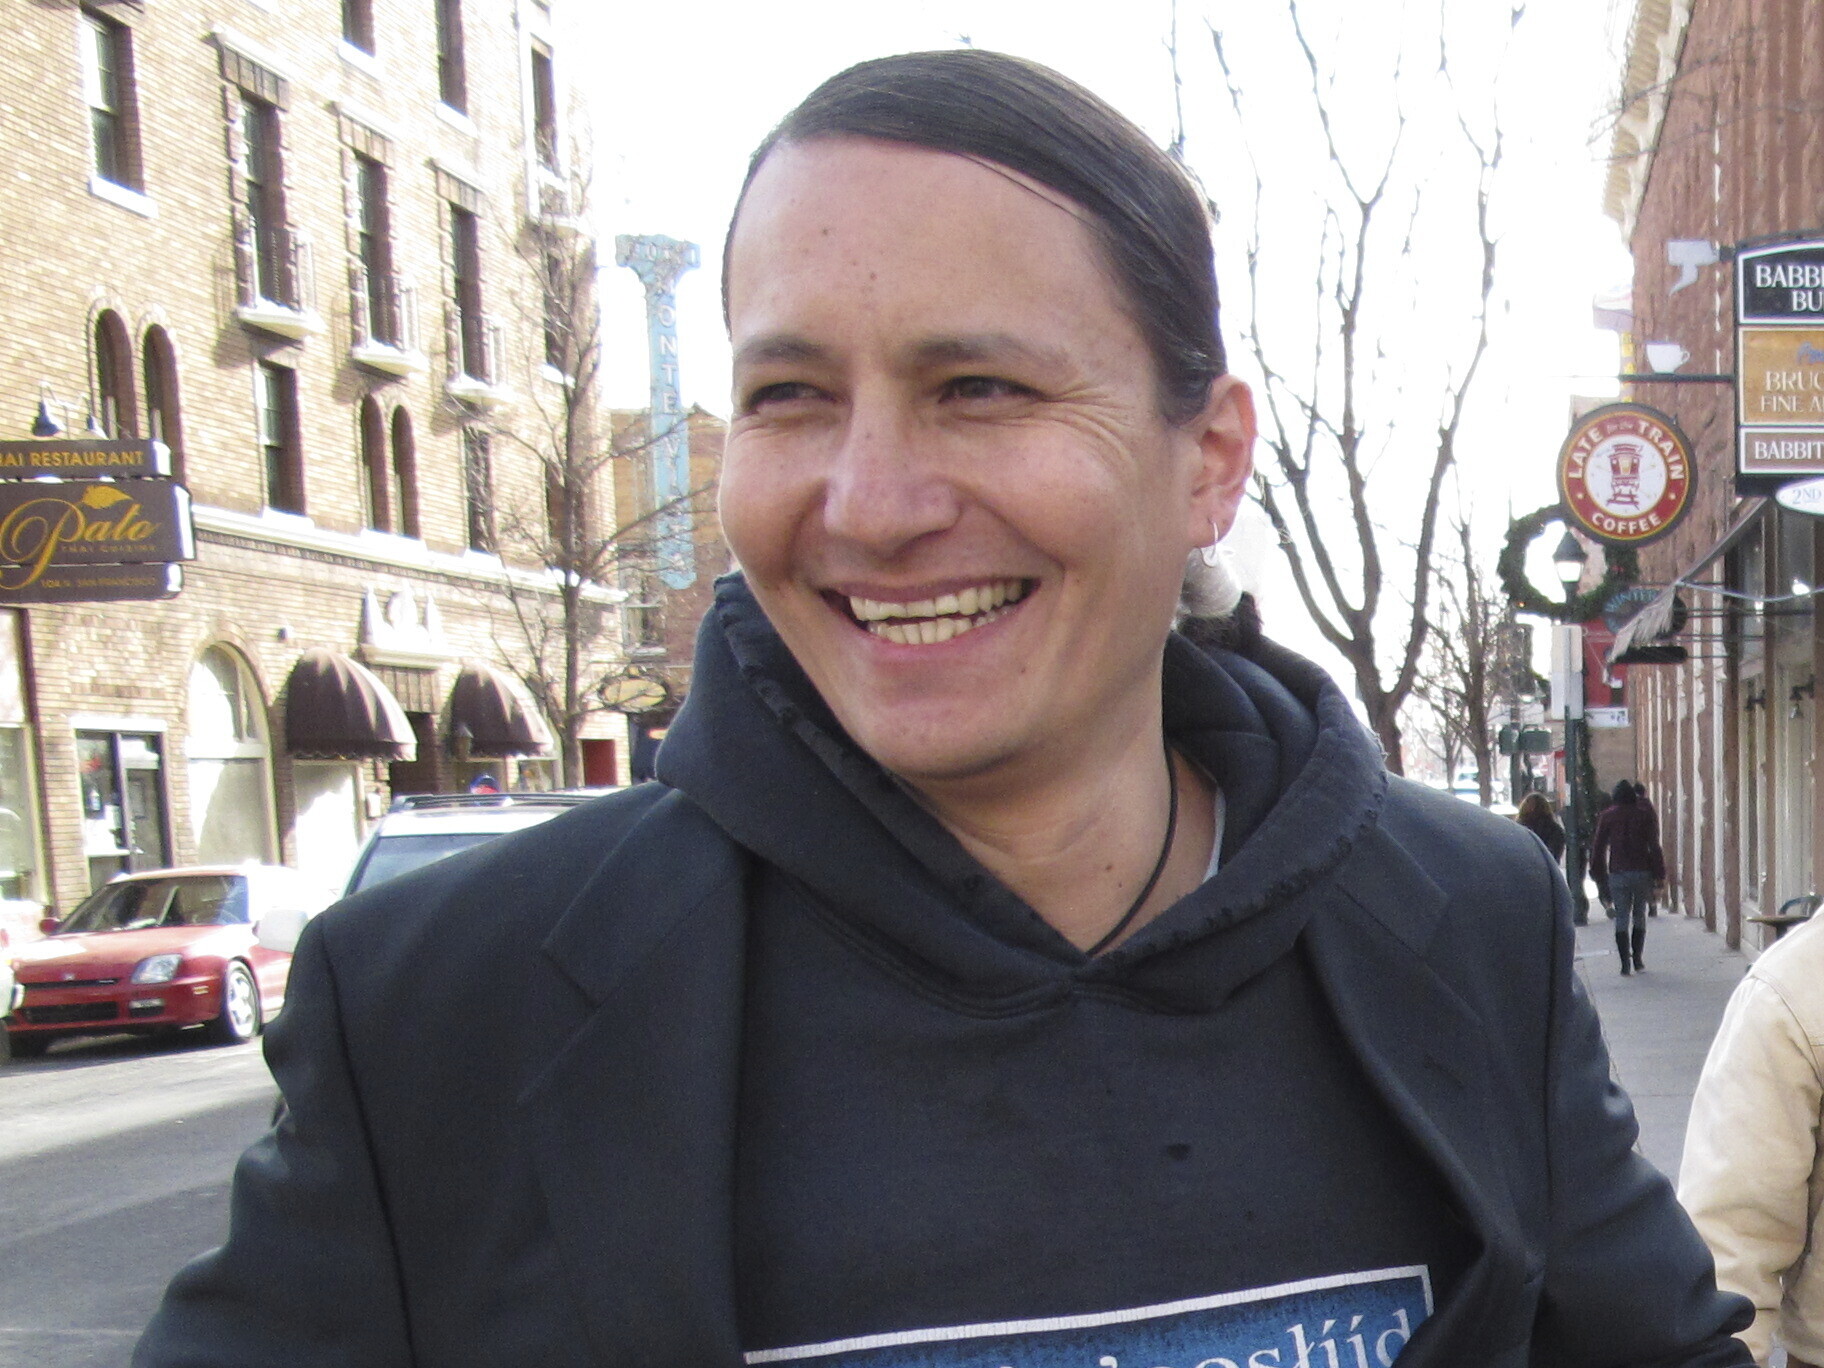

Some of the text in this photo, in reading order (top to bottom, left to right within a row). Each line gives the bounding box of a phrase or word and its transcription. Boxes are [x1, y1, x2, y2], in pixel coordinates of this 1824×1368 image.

[1760, 395, 1804, 413] FINE
[29, 451, 145, 467] RESTAURANT
[1568, 427, 1604, 479] LATE
[1638, 420, 1685, 480] TRAIN
[1592, 512, 1662, 535] COFFEE
